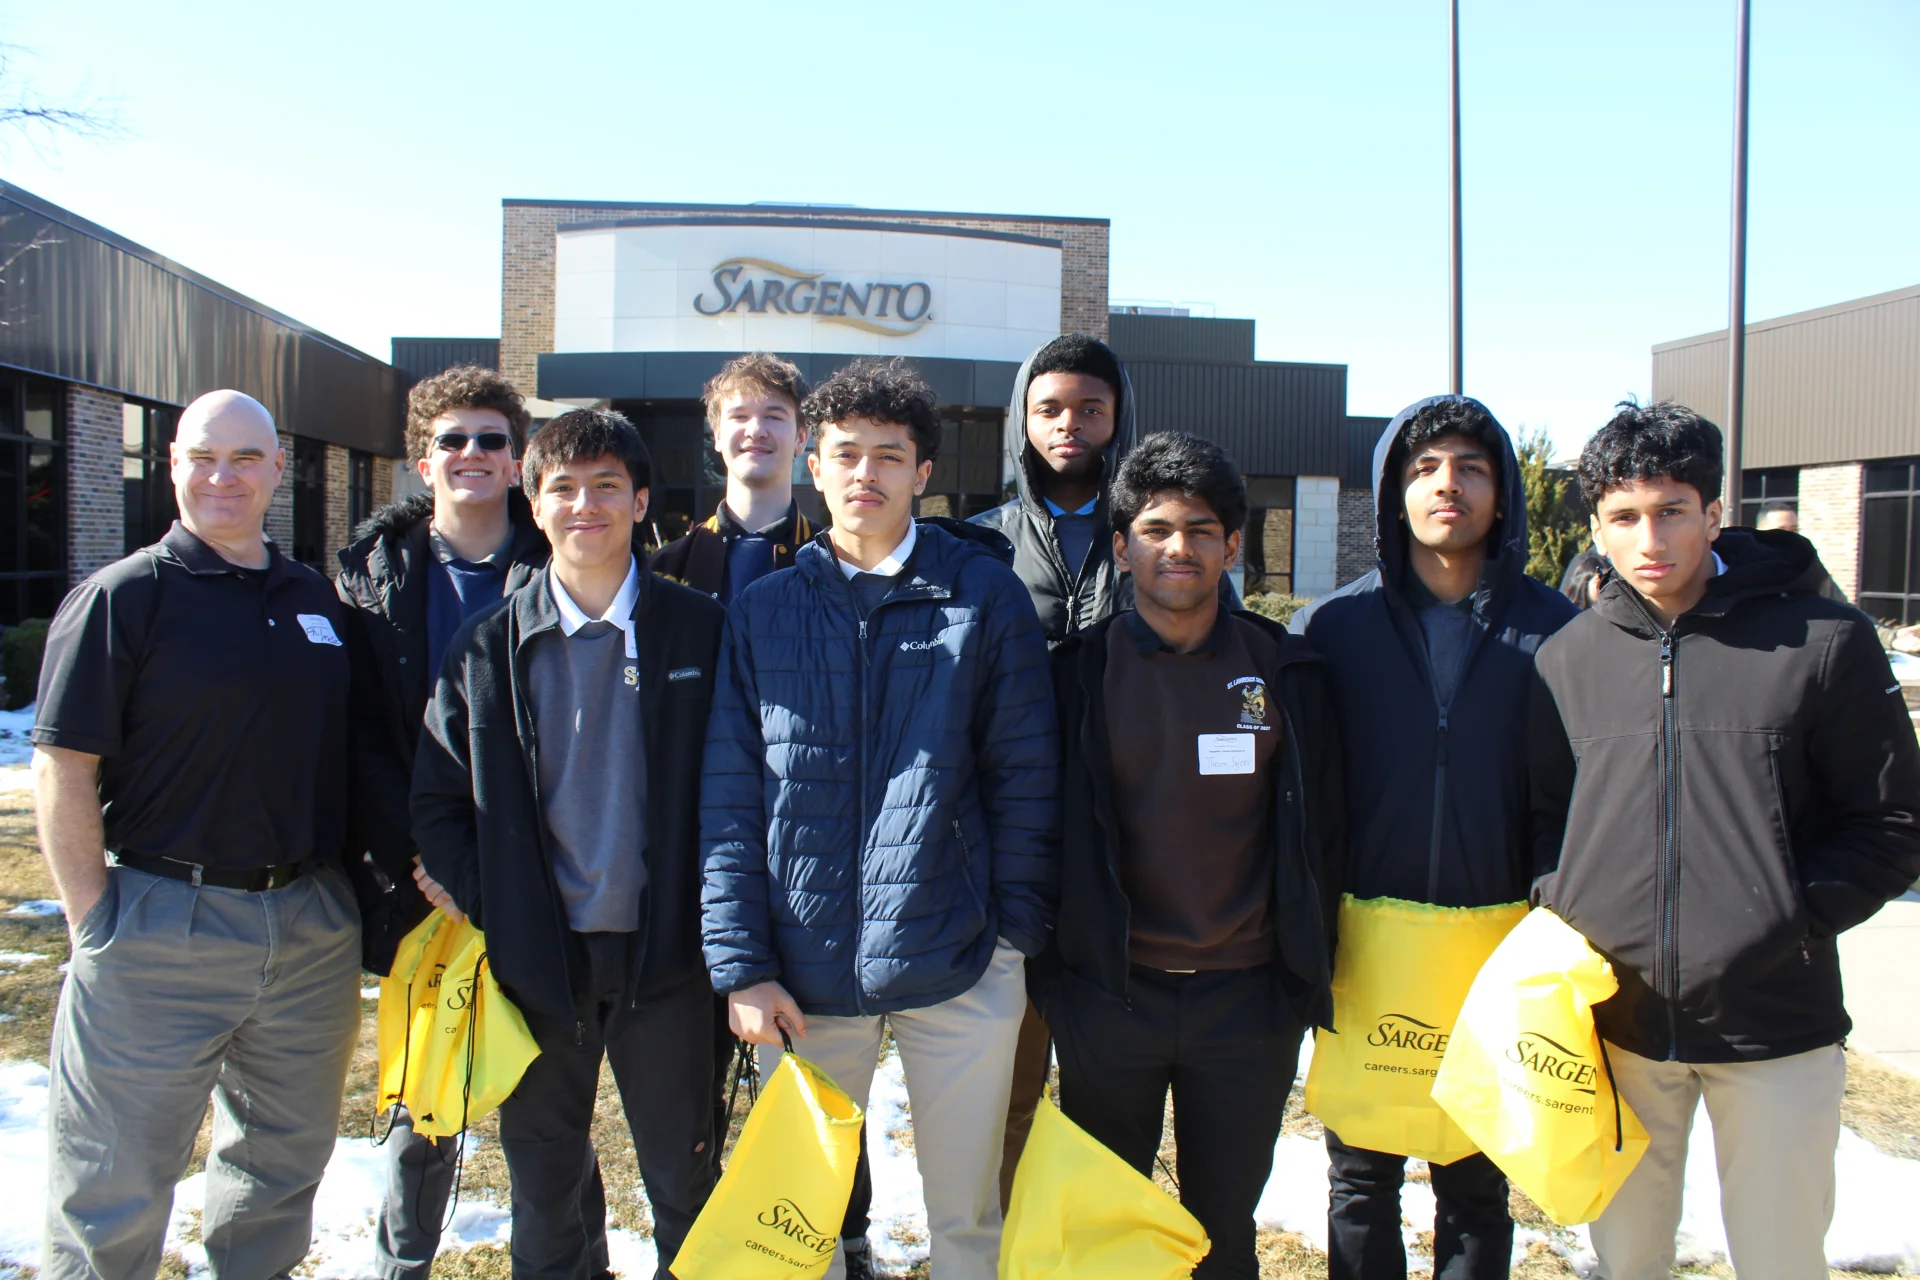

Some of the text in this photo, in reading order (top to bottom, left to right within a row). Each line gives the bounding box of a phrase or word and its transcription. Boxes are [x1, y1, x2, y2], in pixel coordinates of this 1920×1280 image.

[693, 266, 931, 322] SARGENTO
[910, 637, 944, 650] Columbia
[1502, 1077, 1596, 1116] creers.sargent
